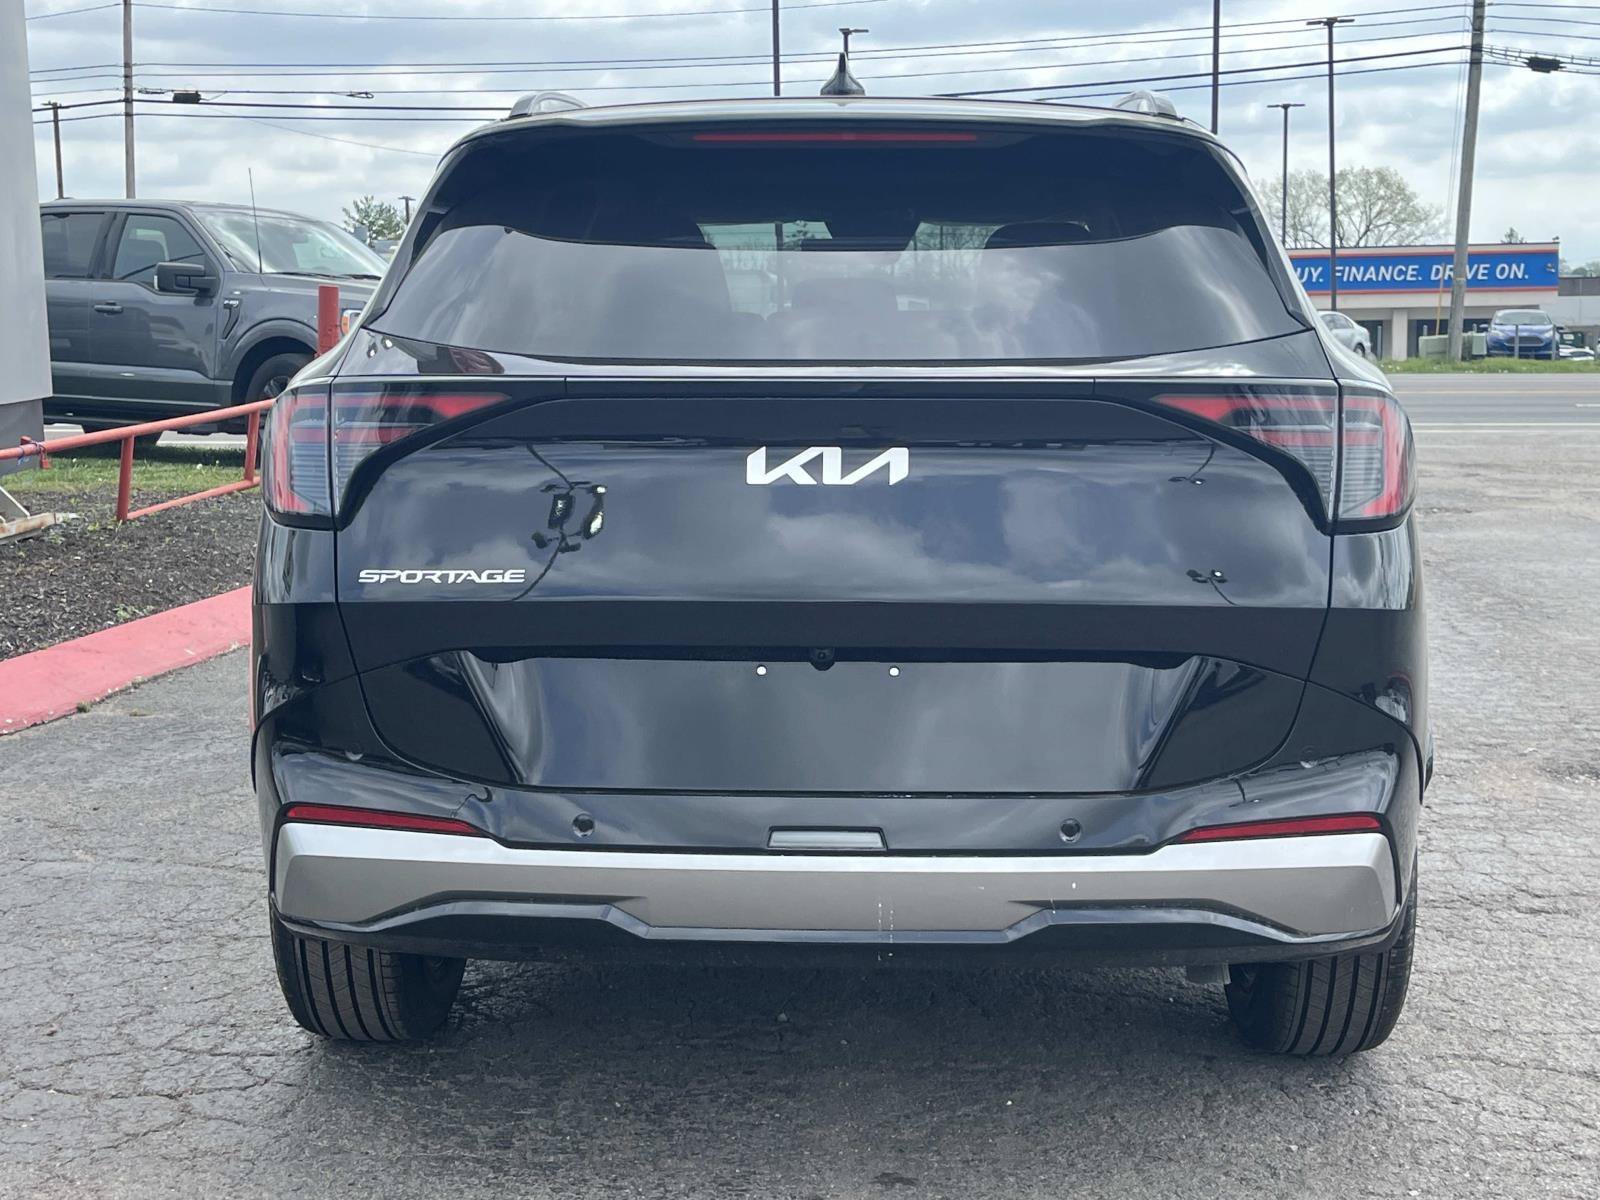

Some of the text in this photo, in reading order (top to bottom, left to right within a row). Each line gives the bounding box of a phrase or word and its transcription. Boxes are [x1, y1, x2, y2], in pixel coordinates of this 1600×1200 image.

[1296, 266, 1323, 283] UY.
[1430, 263, 1490, 281] DRVE
[1495, 263, 1529, 280] ON.
[746, 446, 909, 485] KIA
[358, 569, 526, 584] SPORTAGE
